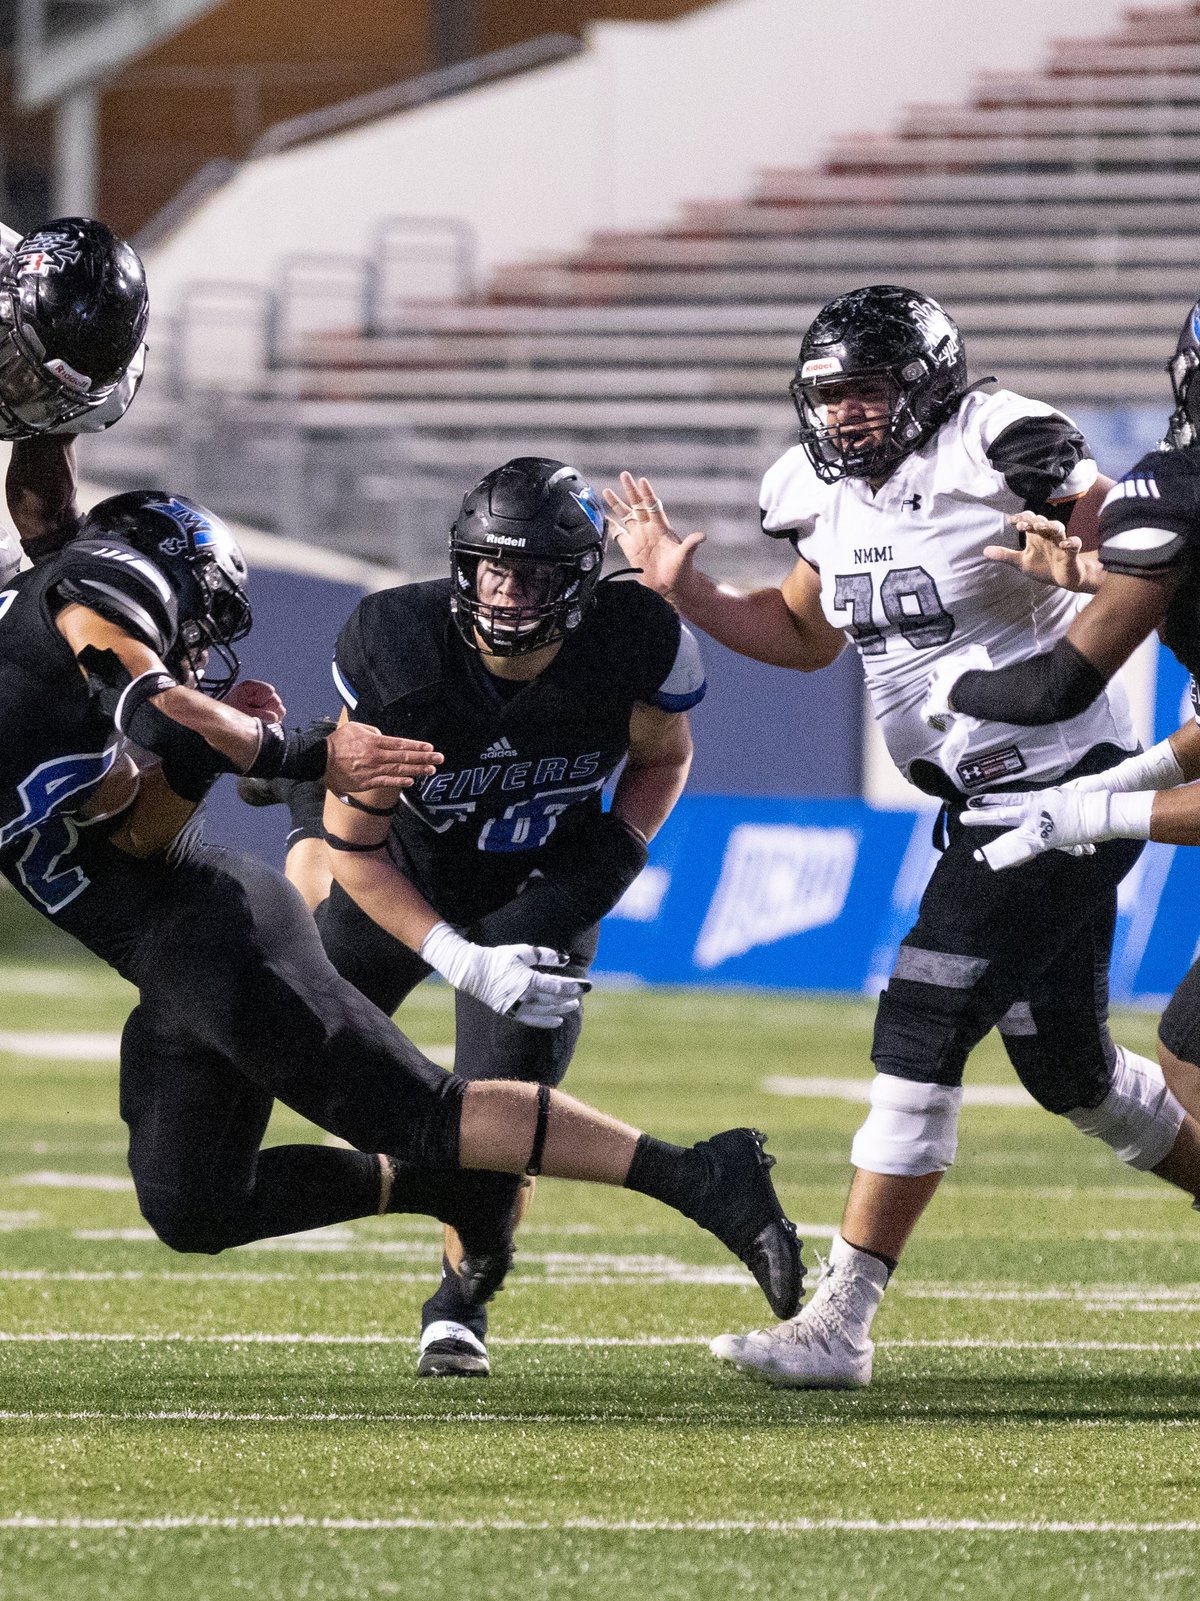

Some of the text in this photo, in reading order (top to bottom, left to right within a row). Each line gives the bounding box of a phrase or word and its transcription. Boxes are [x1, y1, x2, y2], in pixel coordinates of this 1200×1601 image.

[486, 534, 526, 548] Riddell
[853, 545, 894, 565] NMMI
[480, 749, 518, 760] adidas
[419, 751, 601, 802] EIVERS
